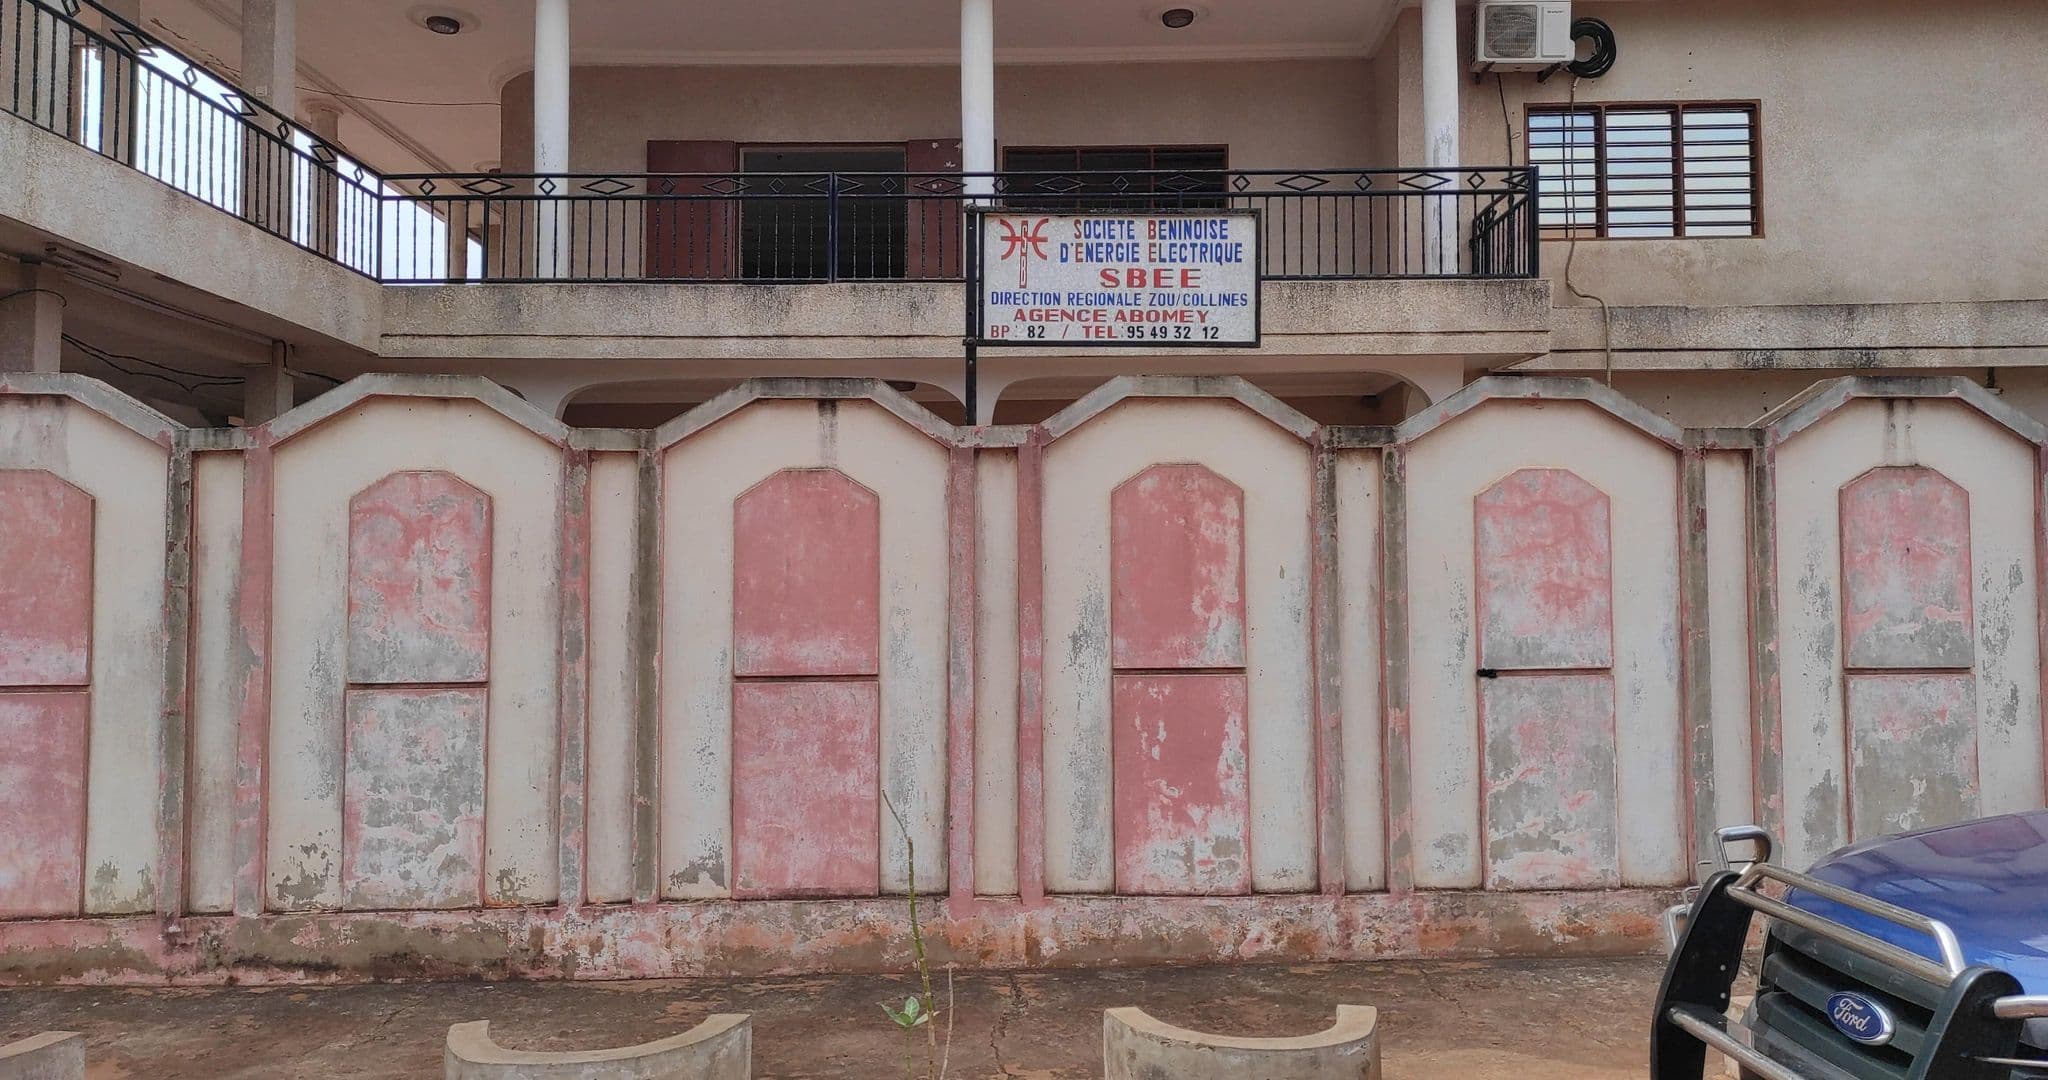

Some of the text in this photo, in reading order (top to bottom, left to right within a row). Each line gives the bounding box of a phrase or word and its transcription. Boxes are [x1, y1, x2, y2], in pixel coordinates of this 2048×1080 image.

[1073, 219, 1229, 240] SOCIETE BENINOISE
[1060, 242, 1243, 266] D'ENERGIE ELECTRIQUE
[1099, 267, 1201, 289] SBEE
[991, 291, 1248, 307] DIRECTION REGIONALE ZOU/COLLINES
[1013, 308, 1210, 323] AGENCE ABOMEY
[1027, 325, 1045, 339] 82
[1127, 325, 1145, 339] 95
[1150, 325, 1168, 339] 49
[1173, 325, 1192, 339] 32
[1202, 326, 1219, 339] 12
[1833, 998, 1871, 1032] Ford
